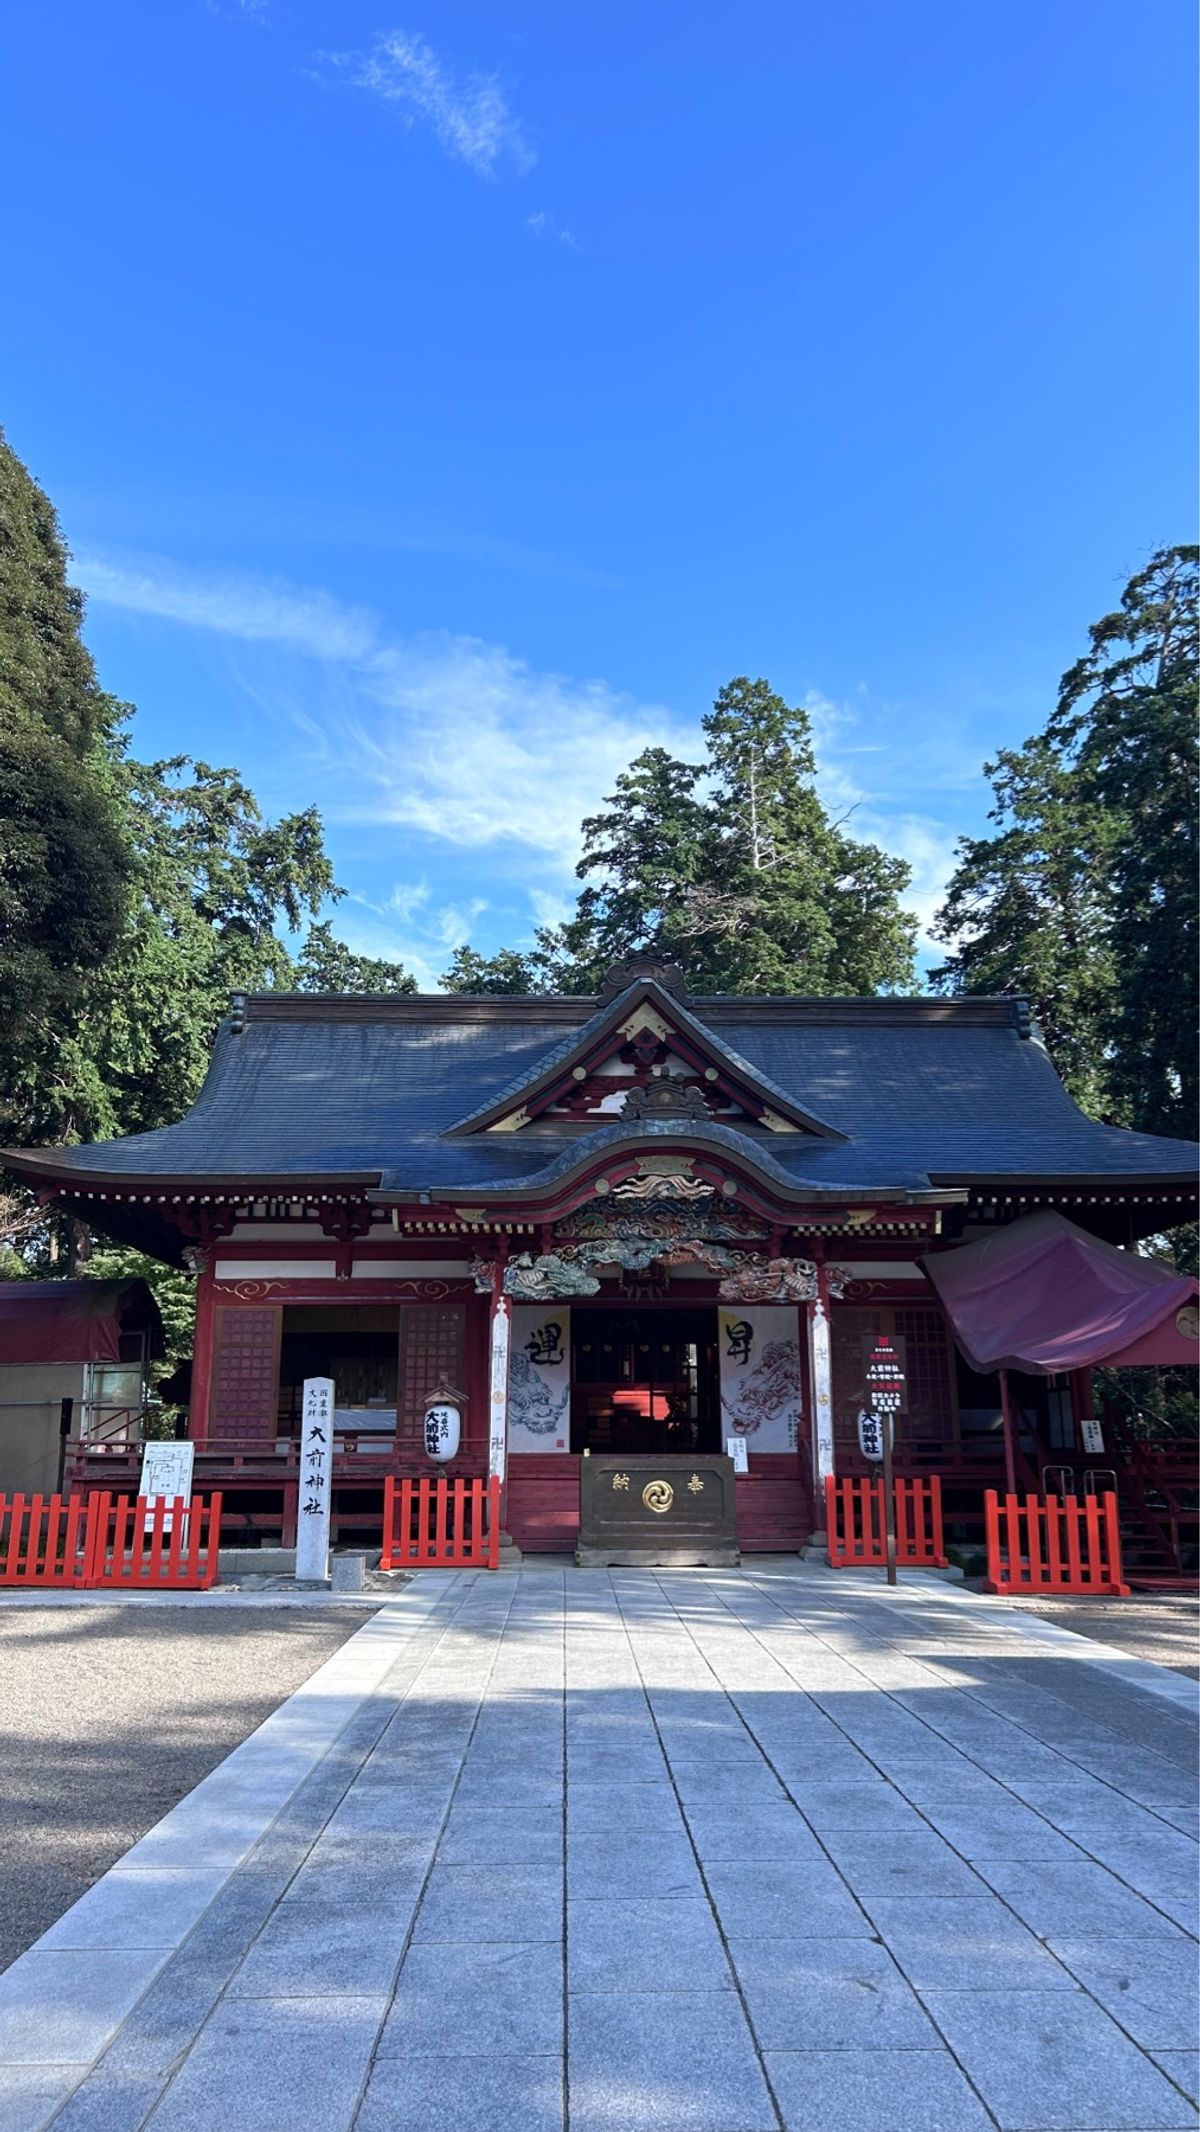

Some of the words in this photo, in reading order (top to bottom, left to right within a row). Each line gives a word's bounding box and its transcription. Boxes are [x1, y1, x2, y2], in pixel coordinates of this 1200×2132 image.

[524, 1322, 565, 1366] 運
[426, 1411, 440, 1454] 大前神社
[861, 1413, 879, 1454] 大前神社
[303, 1426, 326, 1515] 大前神社
